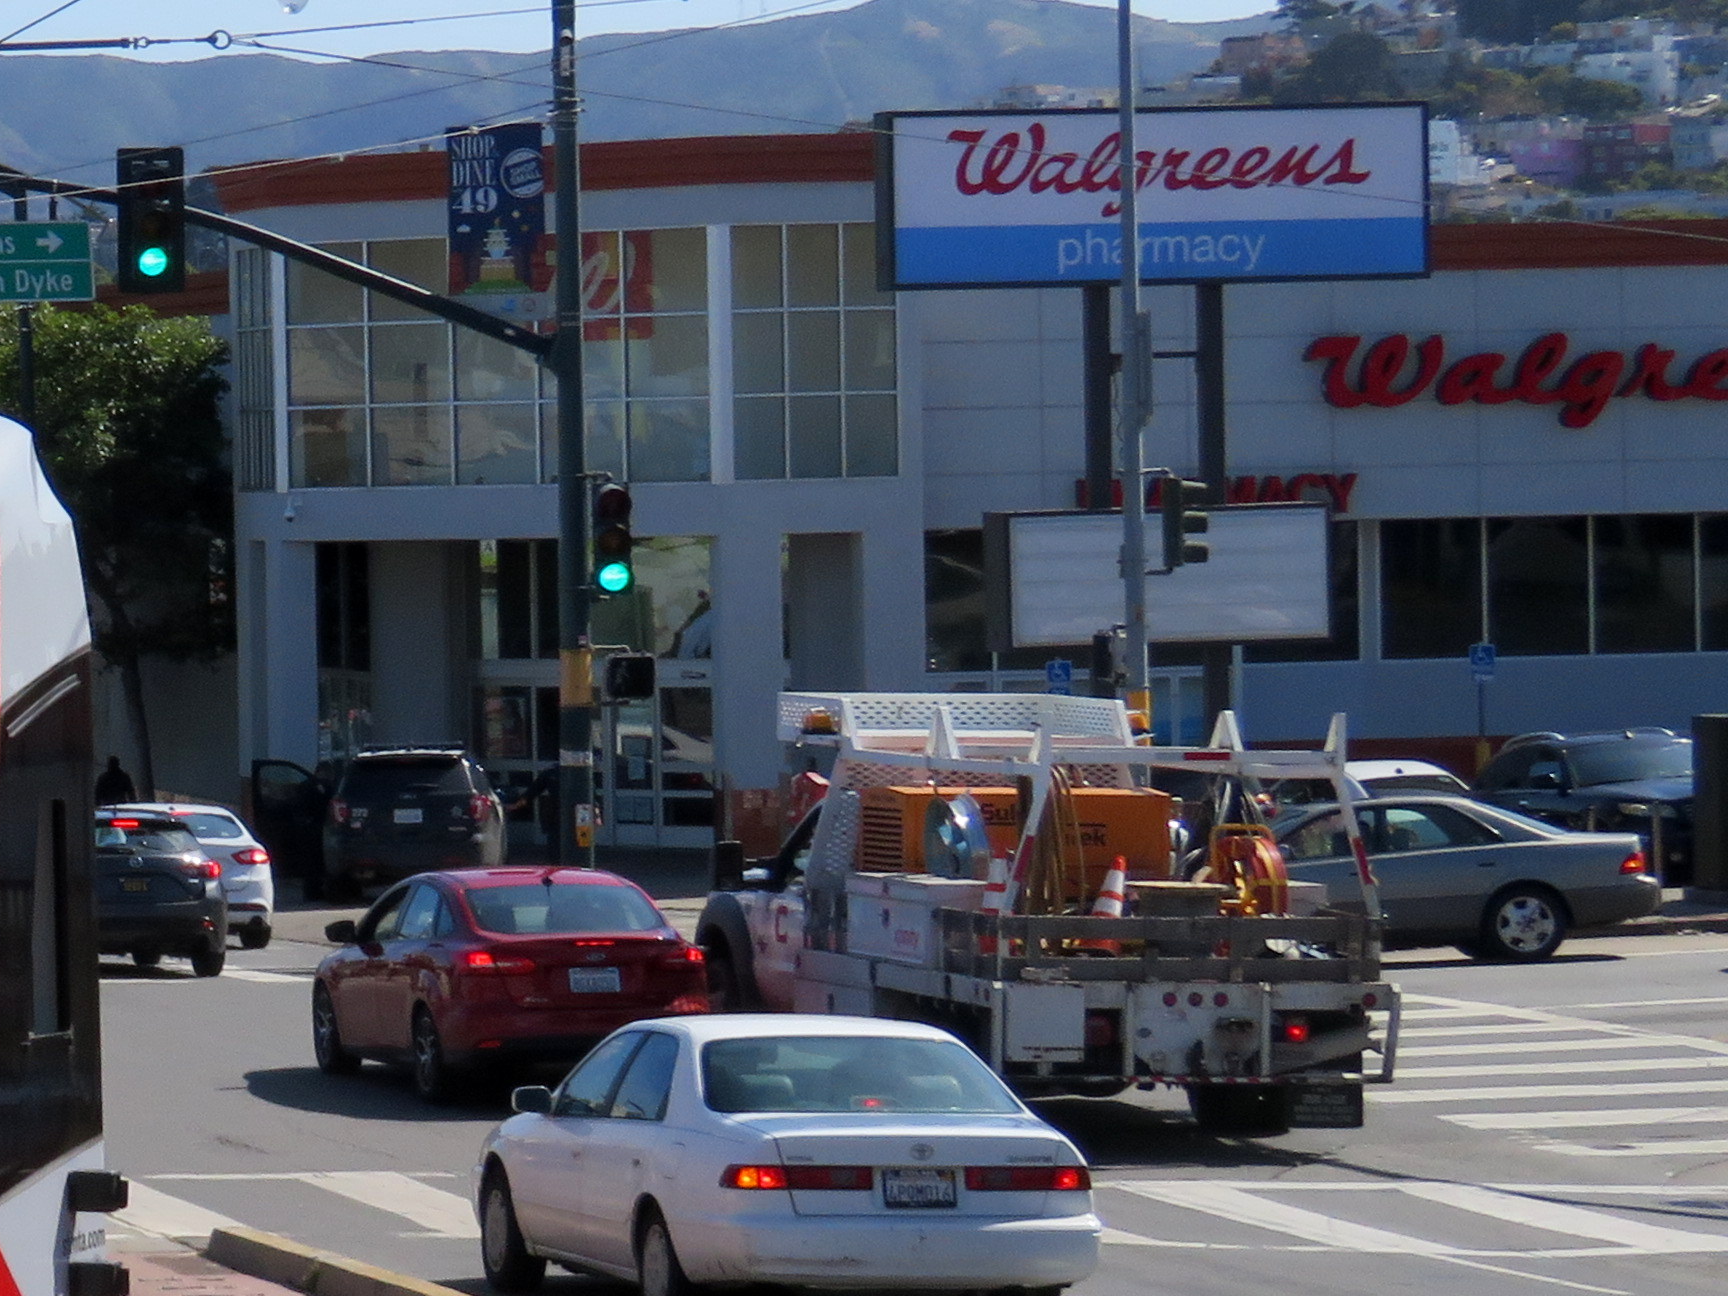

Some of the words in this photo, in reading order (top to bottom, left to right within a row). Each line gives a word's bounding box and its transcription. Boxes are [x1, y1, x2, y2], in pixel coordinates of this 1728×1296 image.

[450, 134, 495, 160] SHOP
[451, 159, 496, 187] DINE
[945, 121, 1372, 218] Walgreens
[451, 186, 498, 215] 49
[1057, 228, 1266, 274] pharmacy
[14, 268, 74, 299] Dyke
